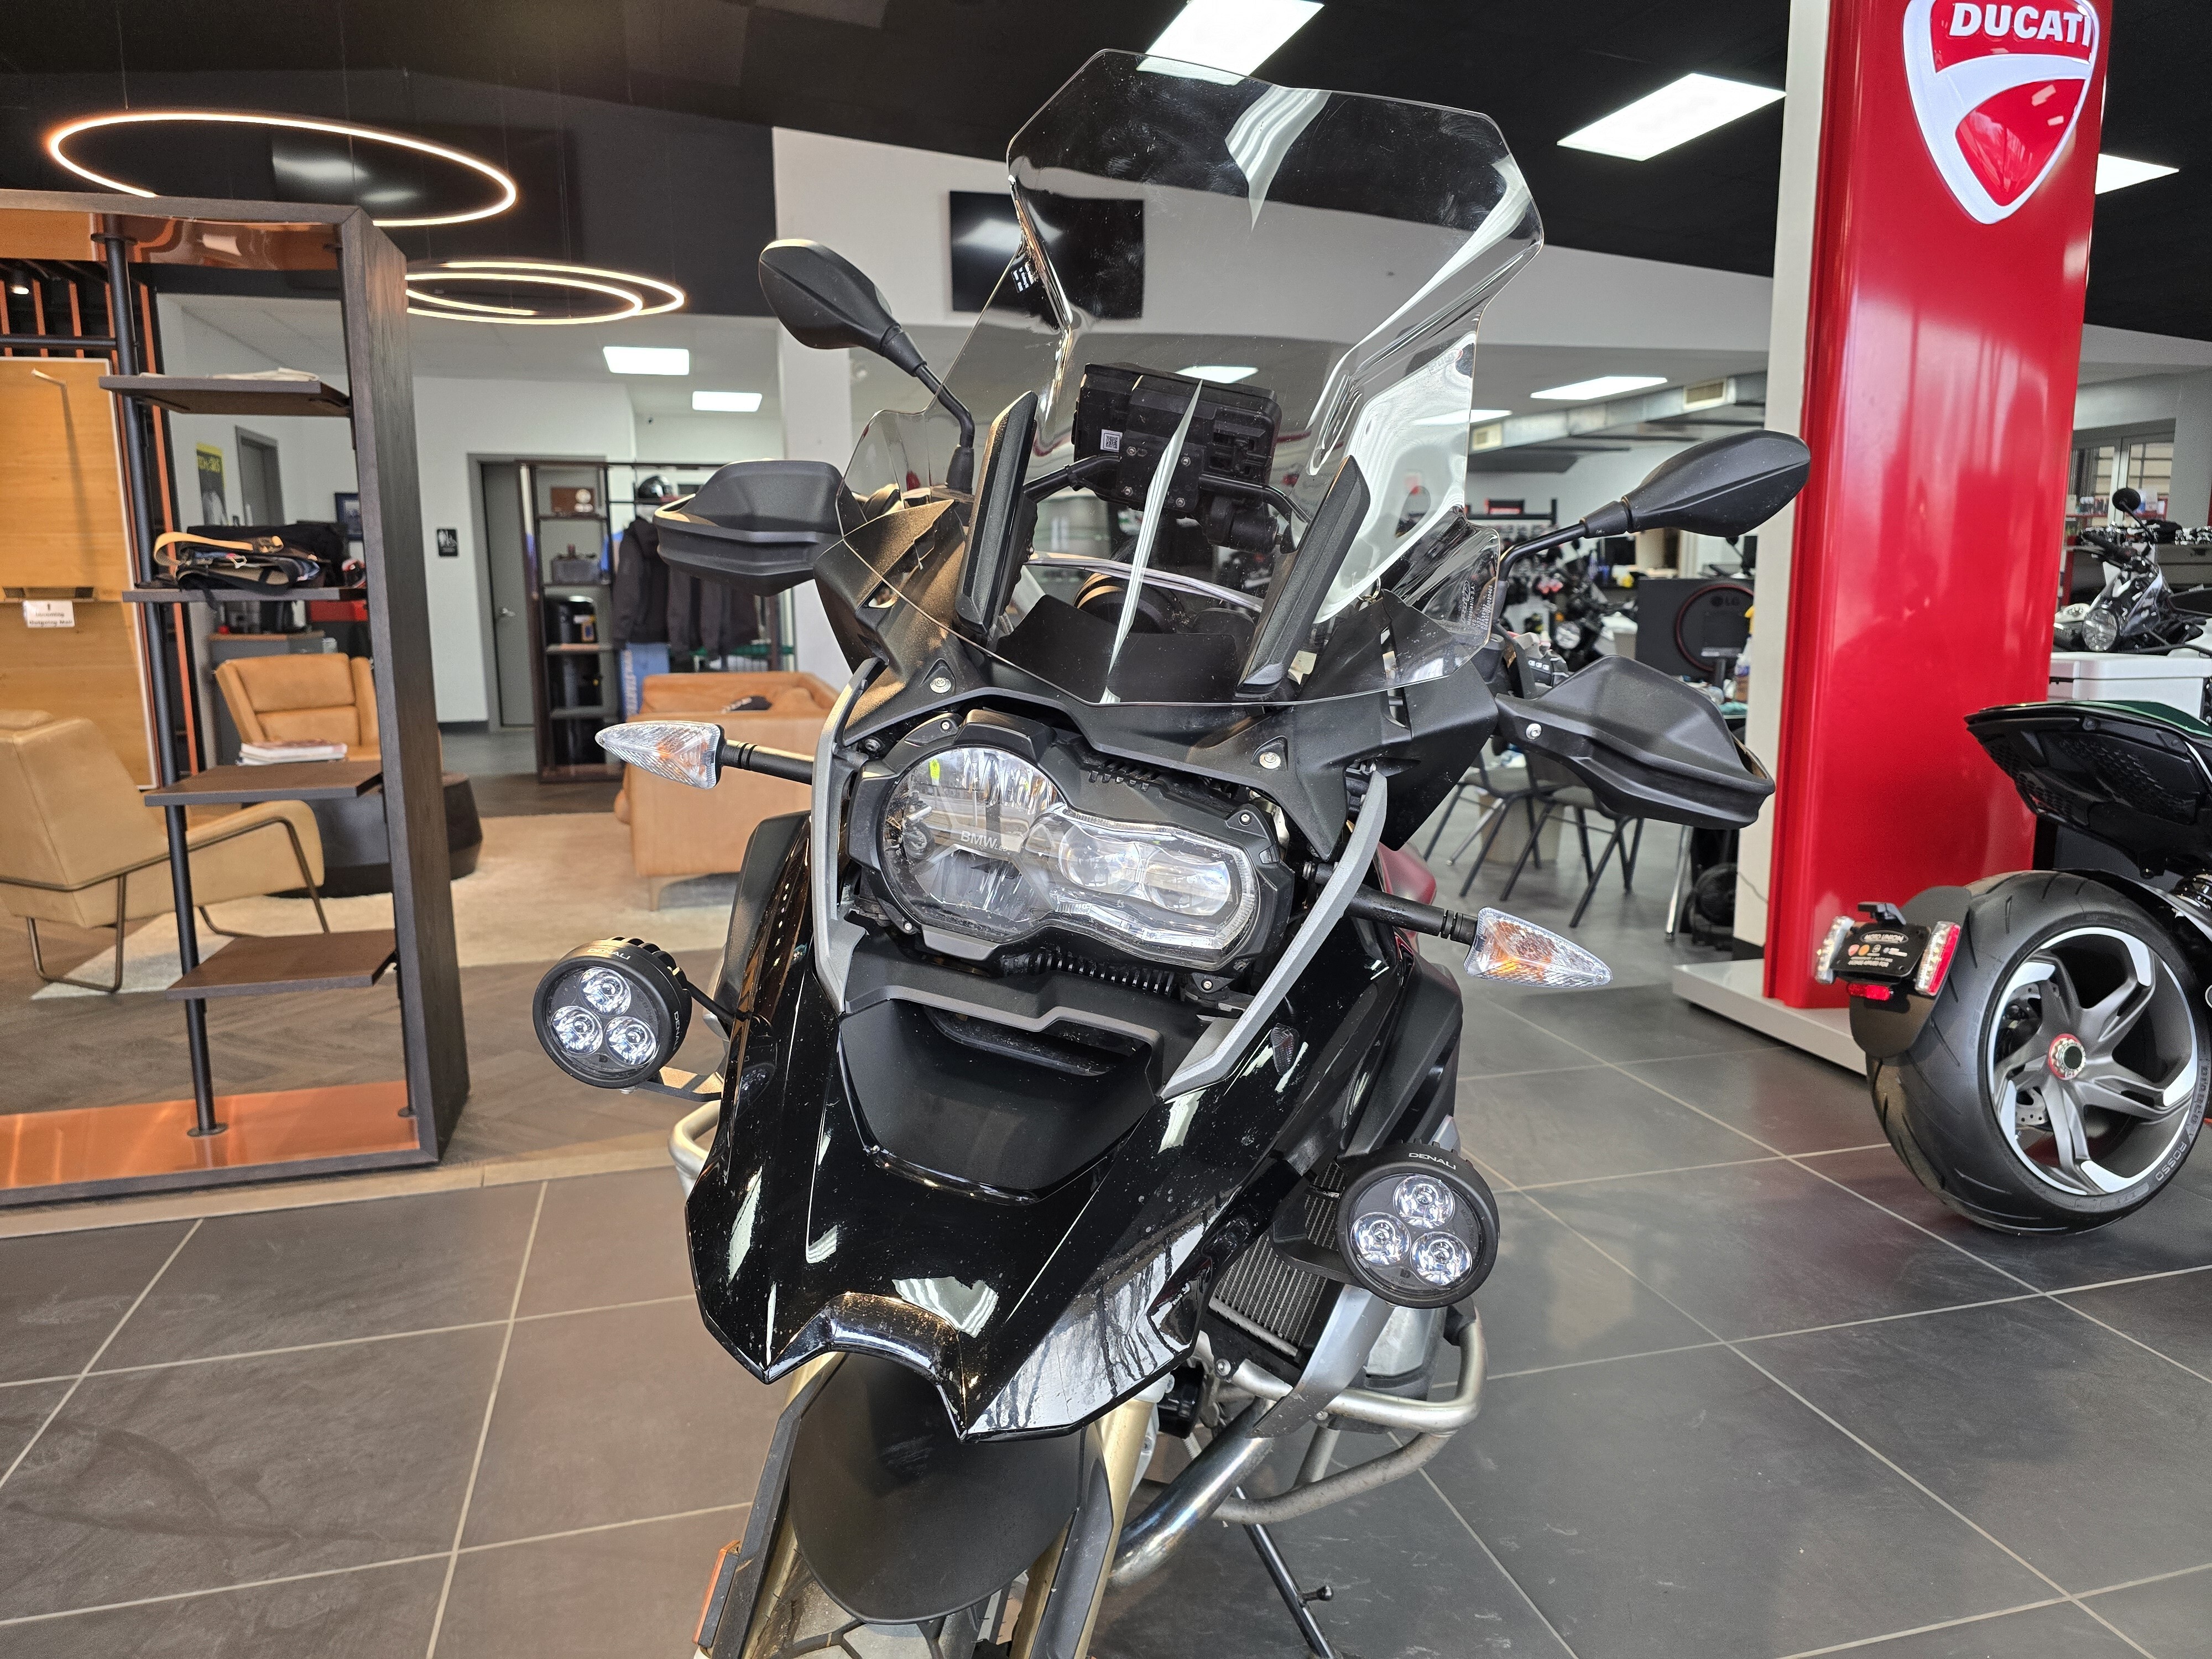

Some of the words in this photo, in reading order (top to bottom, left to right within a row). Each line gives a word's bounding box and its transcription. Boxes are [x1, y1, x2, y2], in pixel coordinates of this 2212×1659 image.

[1949, 3, 2091, 48] DUCATI
[961, 831, 997, 849] BMW
[586, 948, 631, 960] DENALI
[1408, 1152, 1456, 1170] DENALI
[2155, 1141, 2187, 1182] ROSSO
